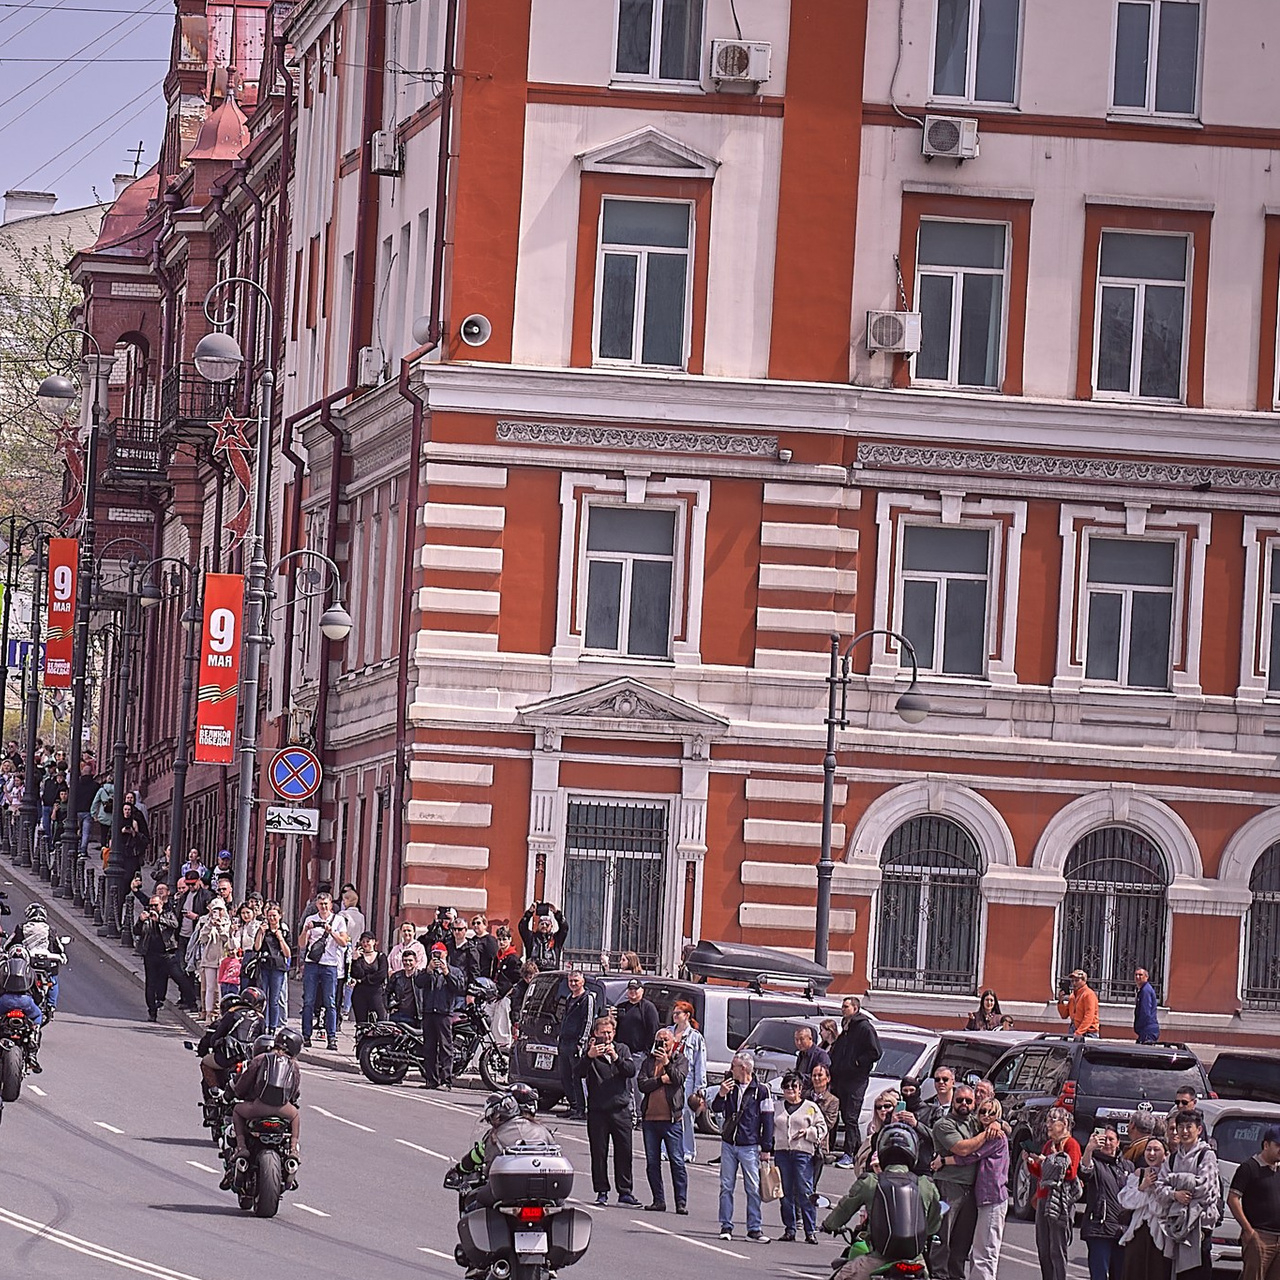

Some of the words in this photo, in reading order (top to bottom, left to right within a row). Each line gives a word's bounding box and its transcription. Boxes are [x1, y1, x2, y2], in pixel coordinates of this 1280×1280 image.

[53, 565, 72, 600] 9
[53, 601, 71, 612] МАЯ
[209, 608, 235, 652] 9
[207, 654, 233, 667] МАЯ
